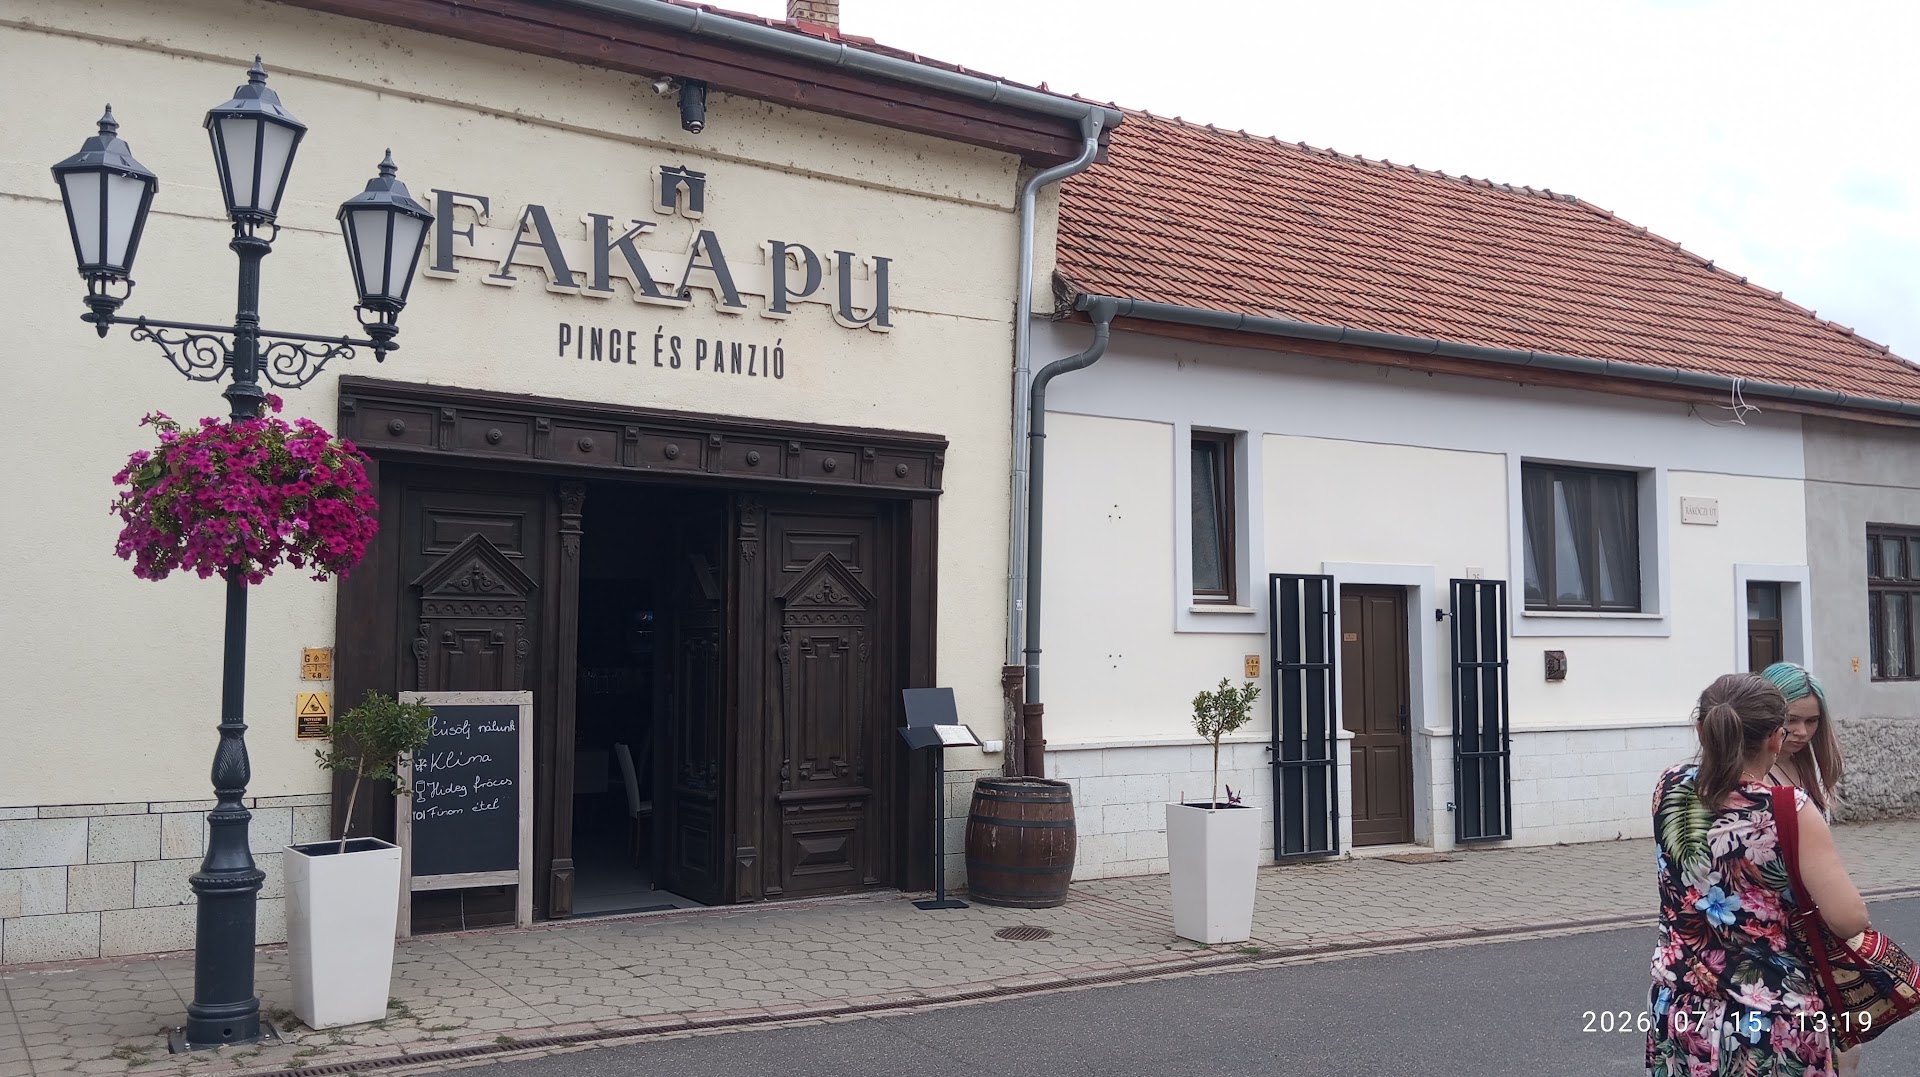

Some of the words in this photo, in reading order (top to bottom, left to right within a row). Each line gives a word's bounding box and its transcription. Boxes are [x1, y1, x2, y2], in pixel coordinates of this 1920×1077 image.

[559, 322, 637, 365] PINCE
[654, 325, 682, 369] ÉS
[696, 338, 785, 380] PANZIÓ
[304, 654, 311, 663] G
[478, 719, 516, 733] nálunk
[427, 781, 468, 799] Hideg
[427, 805, 464, 819] Finom
[472, 797, 500, 812] étel
